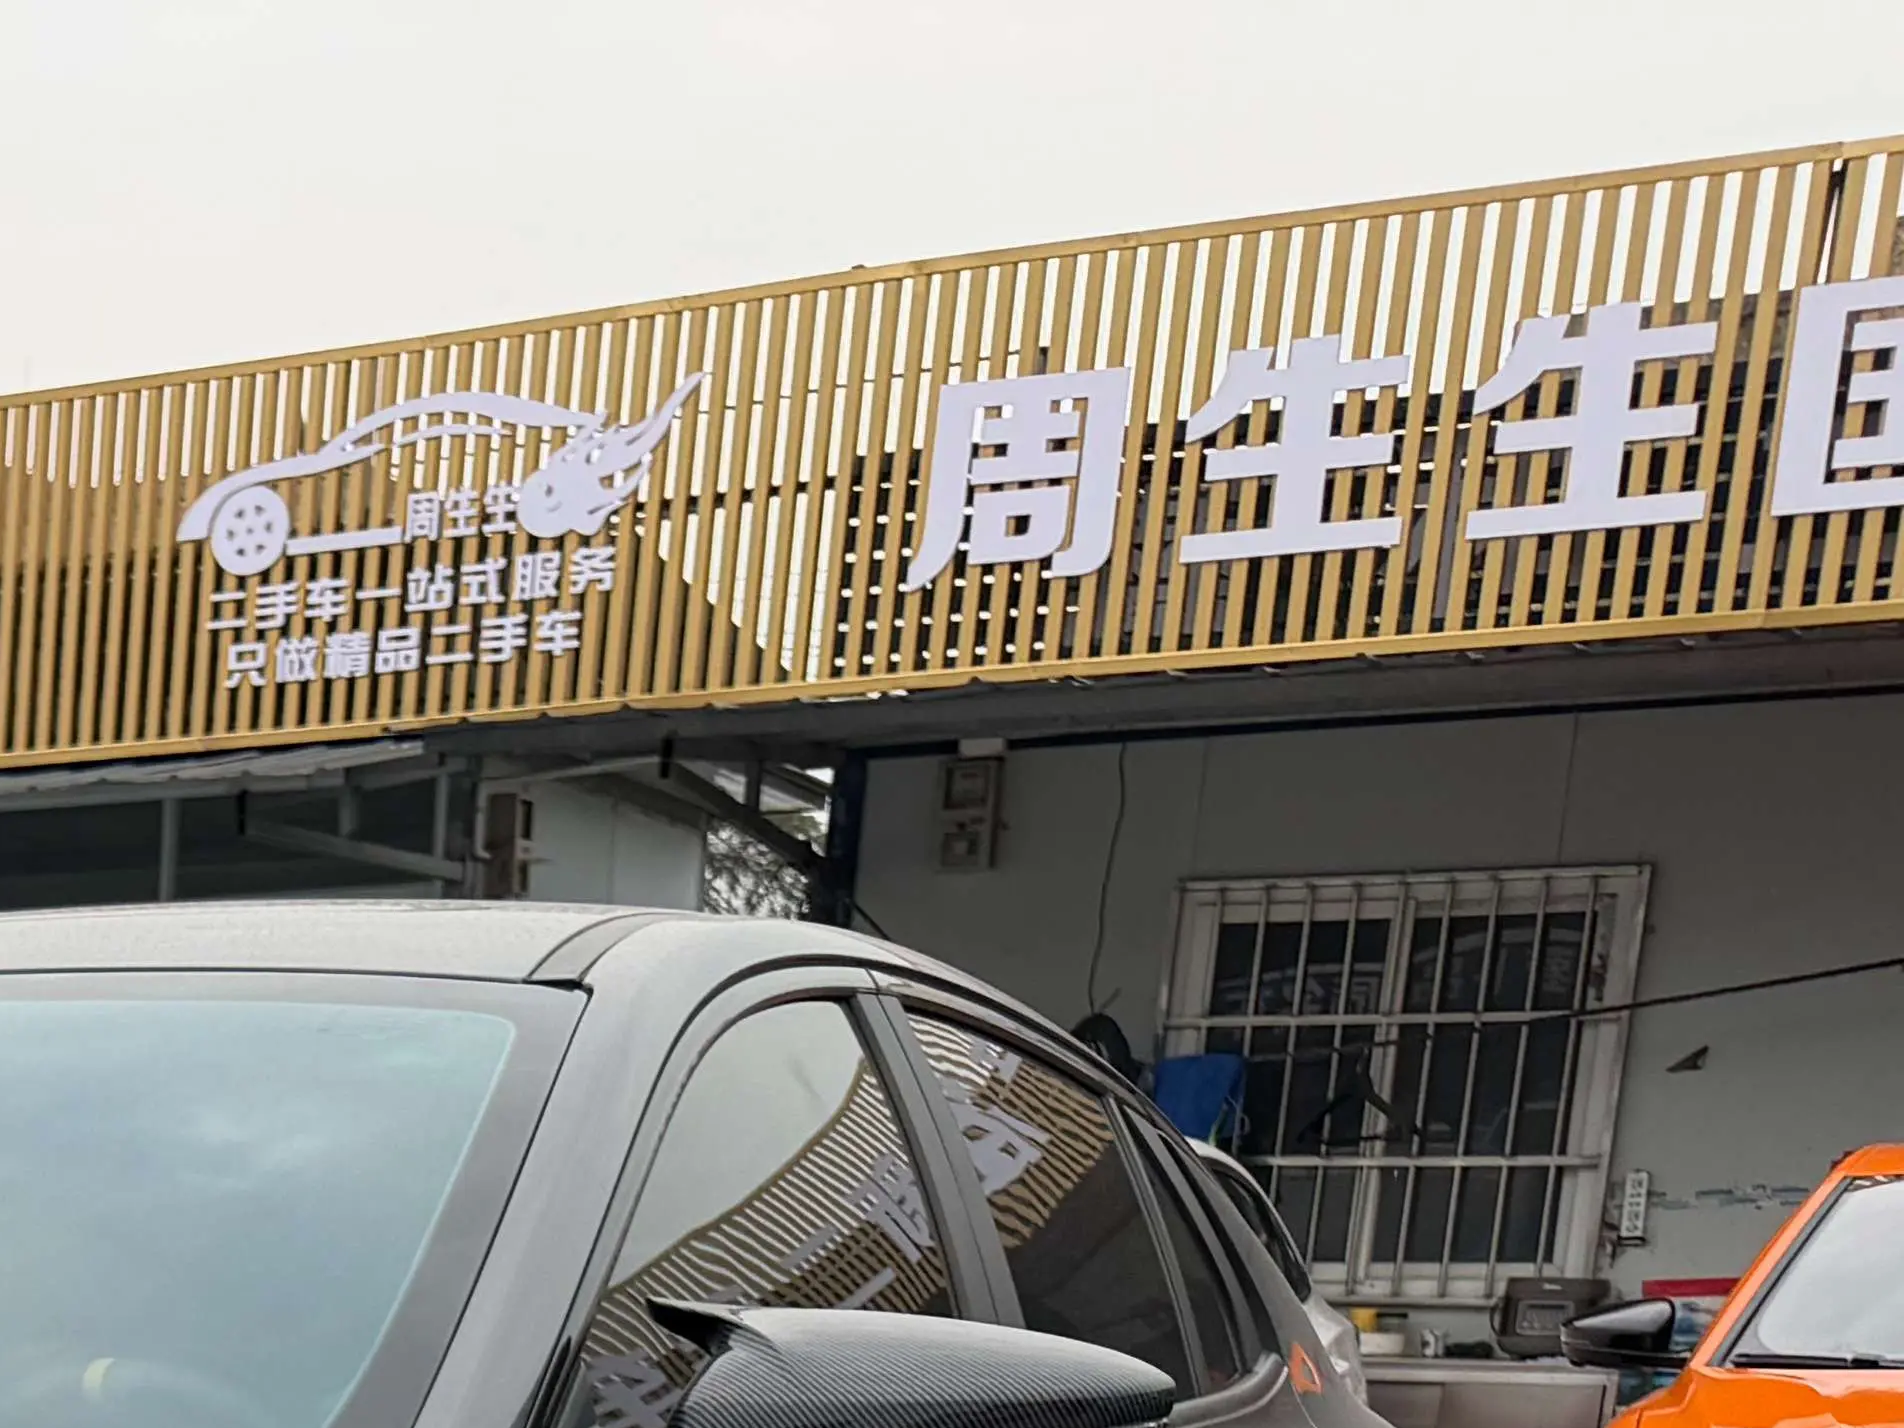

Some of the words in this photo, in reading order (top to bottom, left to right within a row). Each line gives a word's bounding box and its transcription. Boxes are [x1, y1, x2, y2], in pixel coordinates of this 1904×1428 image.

[206, 545, 616, 631] 二手车一站式服务
[224, 610, 582, 689] 只做精品二手车
